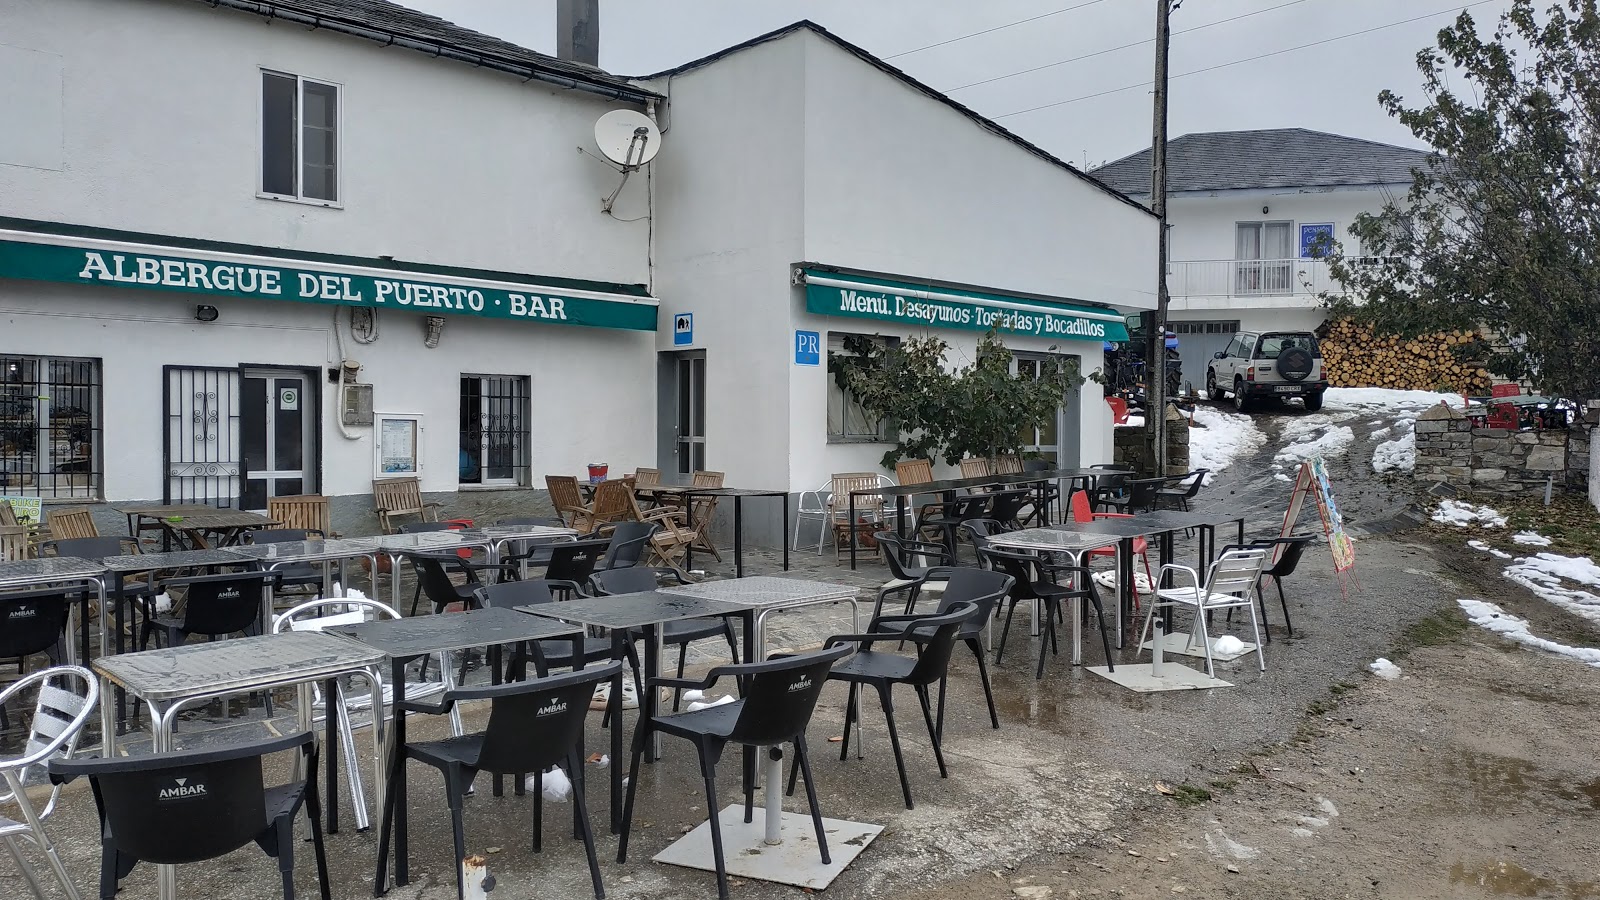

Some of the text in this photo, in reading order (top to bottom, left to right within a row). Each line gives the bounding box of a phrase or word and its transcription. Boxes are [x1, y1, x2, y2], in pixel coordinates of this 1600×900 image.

[79, 252, 567, 320] ALBERGUE DEL PUERTO BAR
[840, 289, 892, 316] Menú.
[1035, 317, 1044, 335] y
[1045, 314, 1105, 337] Bocadillos
[797, 334, 819, 354] PR
[10, 498, 40, 507] BIKE
[9, 609, 36, 618] AMBAR
[536, 702, 567, 716] AMBAR
[159, 783, 207, 798] AMBAR
